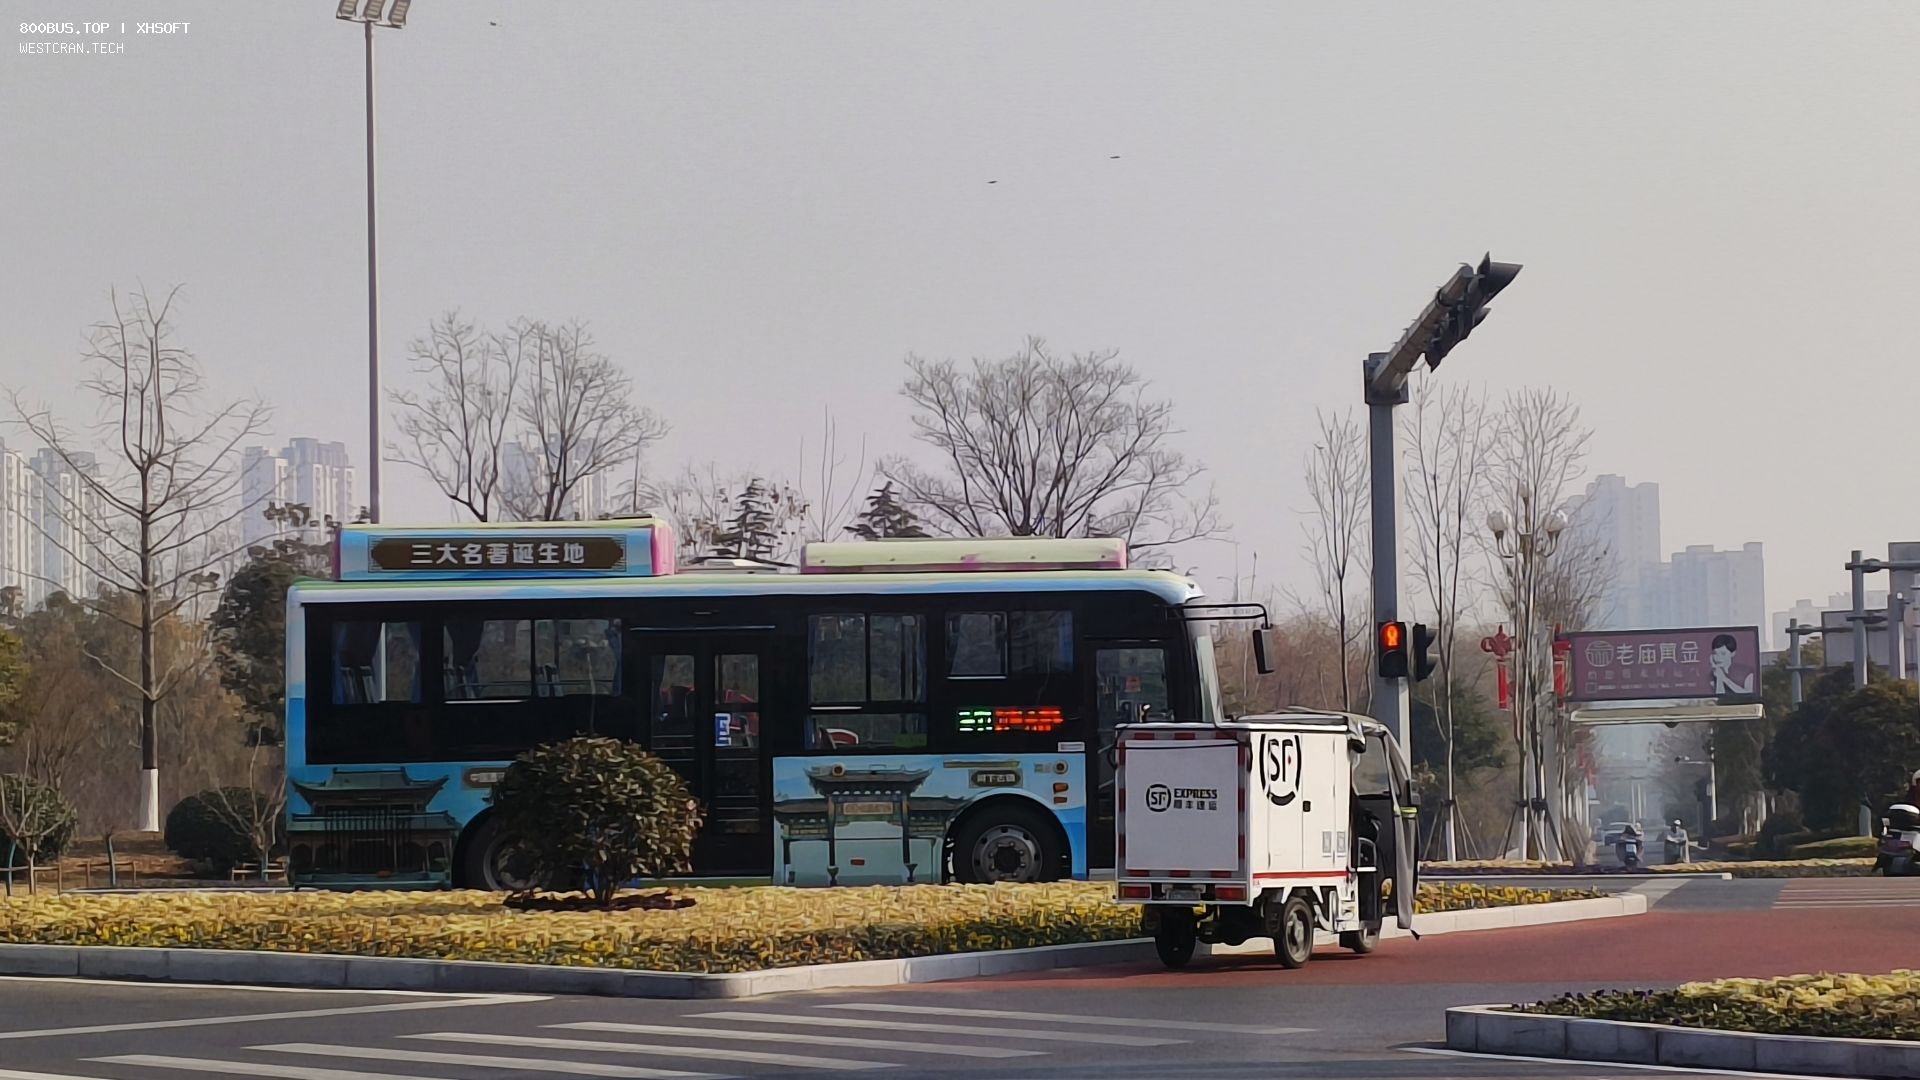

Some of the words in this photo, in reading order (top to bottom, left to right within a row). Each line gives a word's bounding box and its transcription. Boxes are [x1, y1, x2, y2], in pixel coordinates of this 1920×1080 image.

[410, 542, 586, 565] 三大名著诞生地
[1173, 788, 1218, 799] EXPRESS
